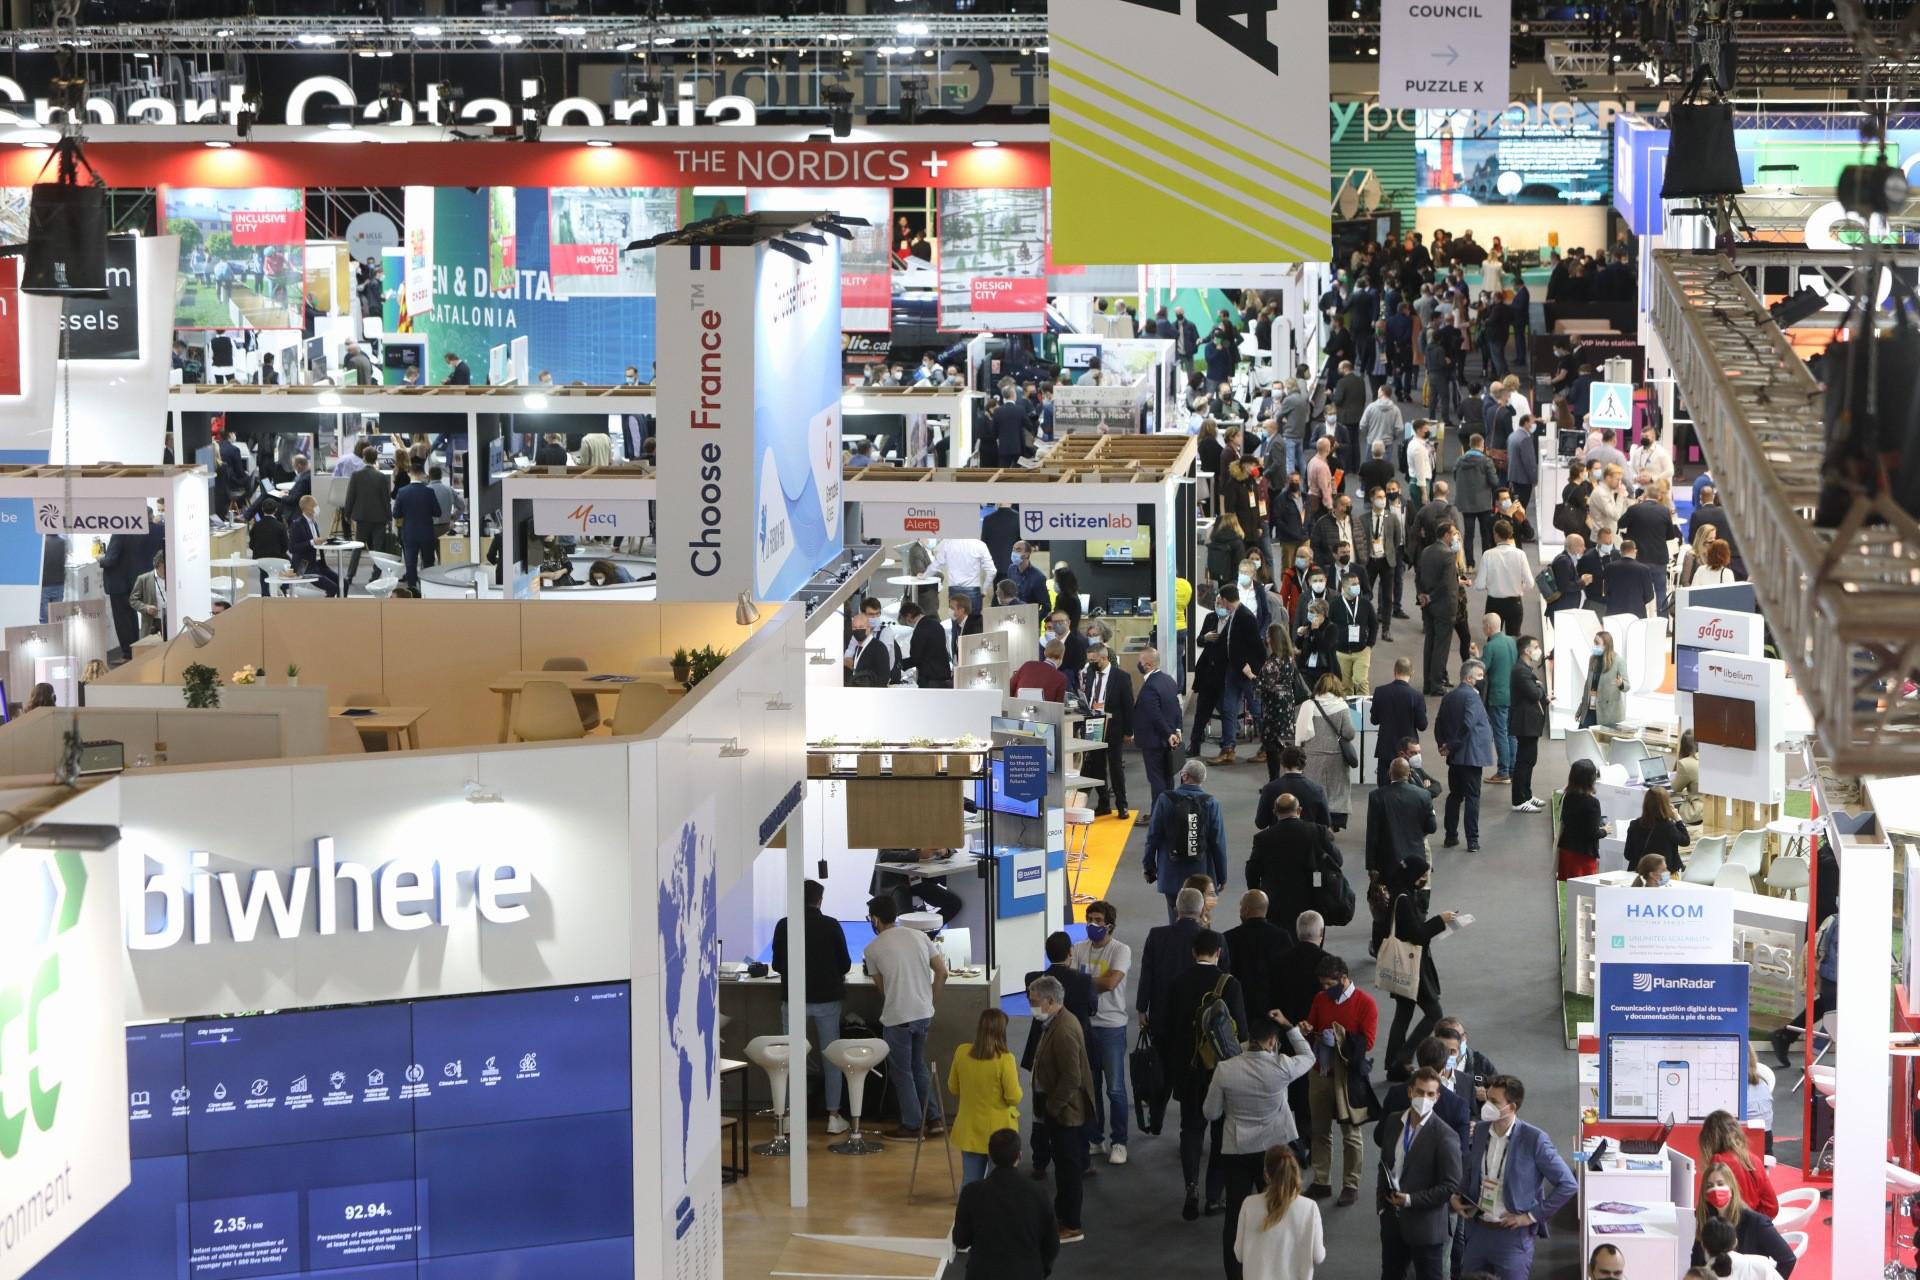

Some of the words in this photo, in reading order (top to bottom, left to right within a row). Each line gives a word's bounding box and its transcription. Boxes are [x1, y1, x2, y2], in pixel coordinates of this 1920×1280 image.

[1409, 5, 1483, 18] COUNCIL
[1406, 80, 1468, 93] PUZZLE
[1473, 81, 1484, 93] X
[673, 150, 726, 172] THE
[737, 150, 910, 181] NORDICS
[235, 214, 287, 224] INCLUSIVE
[235, 223, 258, 233] CITY
[454, 266, 467, 298] &
[975, 281, 1013, 290] DESIGN
[975, 291, 998, 300] CITY
[430, 304, 517, 328] CATALONIA
[690, 310, 721, 429] France
[1056, 411, 1079, 420] Smart
[1081, 411, 1099, 419] with
[1111, 412, 1131, 420] Heart
[688, 443, 721, 577] Choose
[907, 507, 936, 517] Omni
[62, 515, 144, 530] LACROIX
[567, 503, 617, 532] Macq
[1048, 512, 1132, 529] citizenlab
[905, 520, 939, 532] Alerts
[1698, 622, 1735, 641] galgus
[1723, 668, 1753, 680] libelium
[1188, 813, 1198, 857] adidas
[126, 836, 532, 951] biwhere
[1627, 904, 1704, 918] HAKOM
[1653, 977, 1716, 989] PlanRadar
[1610, 1004, 1656, 1012] Comunicación
[1662, 1005, 1685, 1013] gestión
[1687, 1005, 1707, 1013] digital
[1686, 1013, 1698, 1021] pie
